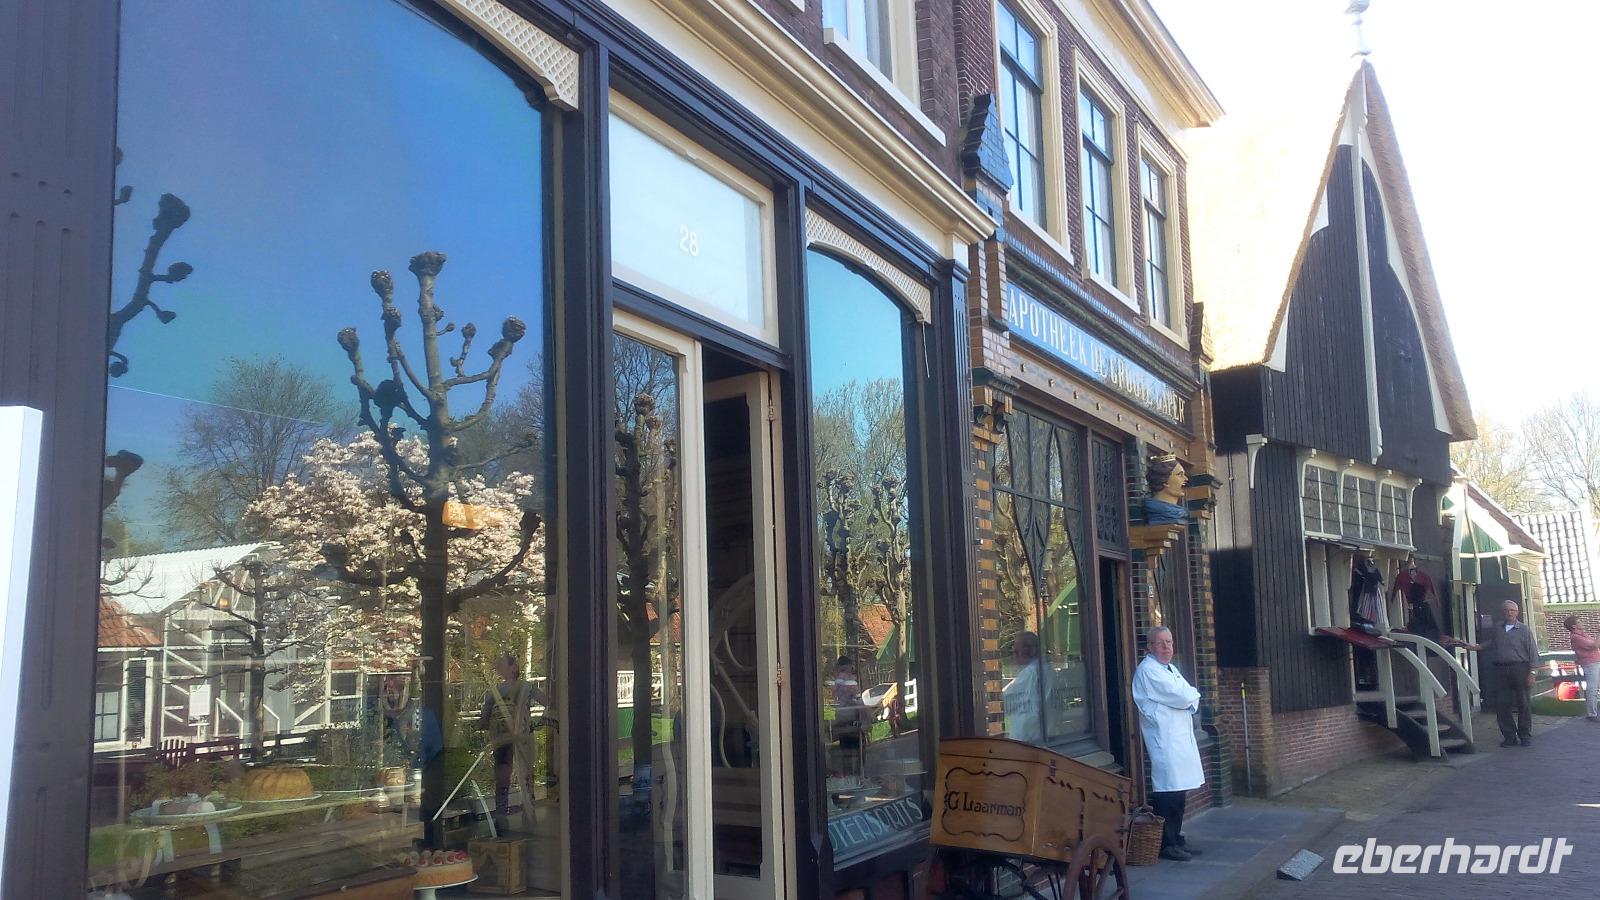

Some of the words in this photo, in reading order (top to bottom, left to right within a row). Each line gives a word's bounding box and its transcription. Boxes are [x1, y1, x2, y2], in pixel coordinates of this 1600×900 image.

[679, 224, 699, 257] 28
[1008, 287, 1087, 366] APOTHEEK
[1090, 340, 1108, 379] DE
[963, 791, 1022, 817] Laarman
